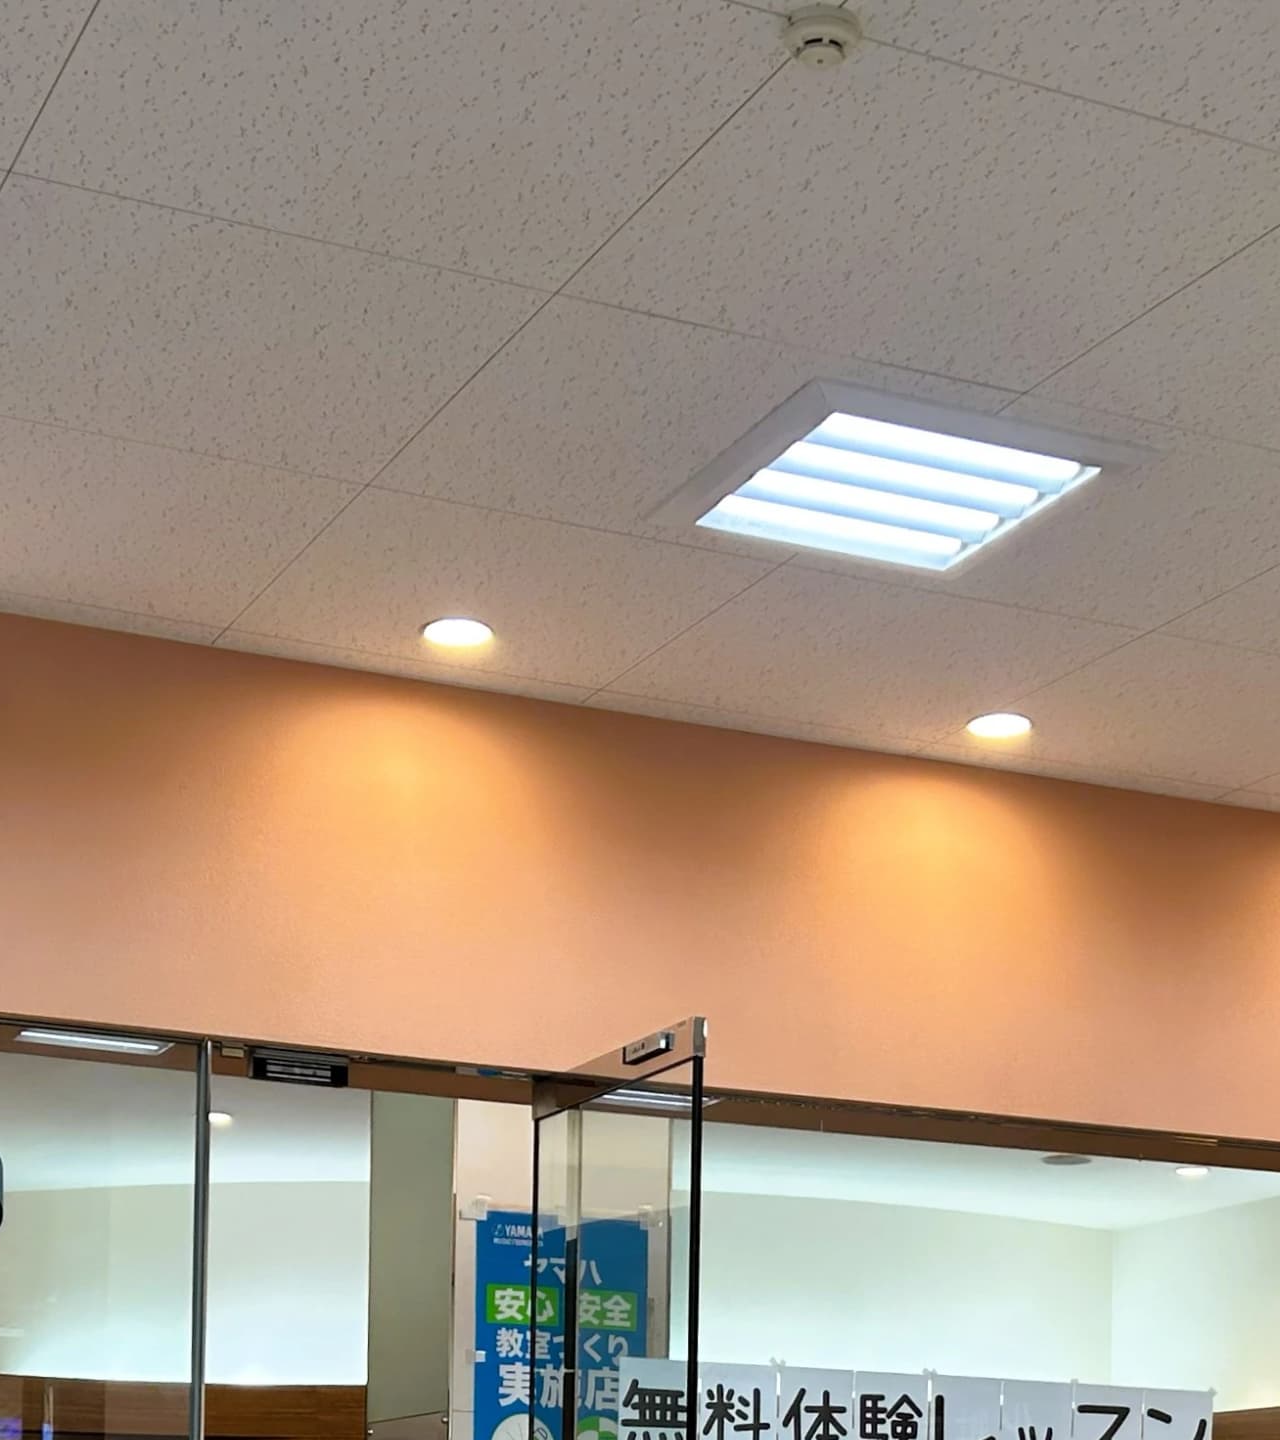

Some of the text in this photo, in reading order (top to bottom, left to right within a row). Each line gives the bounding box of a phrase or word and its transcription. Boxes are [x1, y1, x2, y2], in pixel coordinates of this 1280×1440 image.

[505, 1225, 544, 1238] YAMAA
[494, 1288, 631, 1328] 安心 安全
